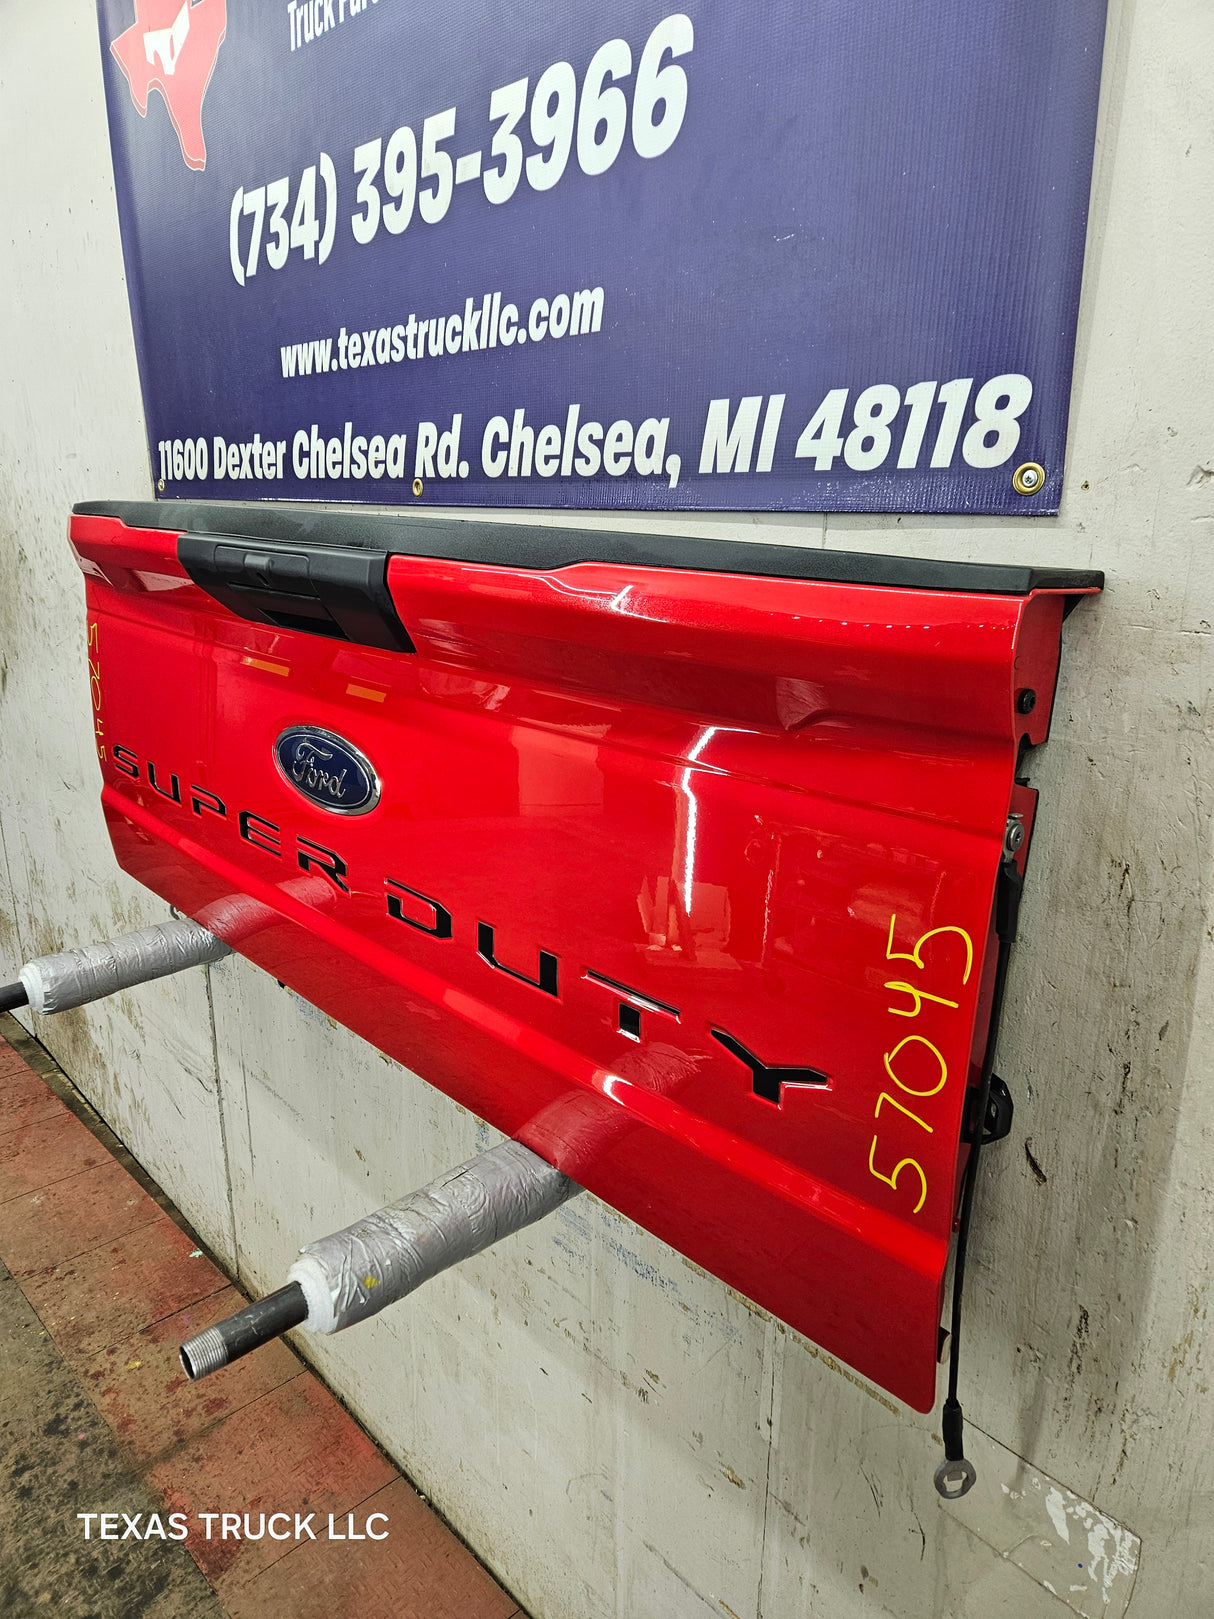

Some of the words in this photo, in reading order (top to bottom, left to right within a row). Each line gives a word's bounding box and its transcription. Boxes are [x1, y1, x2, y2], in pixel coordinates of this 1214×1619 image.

[229, 152, 337, 287] (734)
[350, 12, 694, 245] 395-3966
[280, 286, 605, 378] www.texastruckllc.com
[158, 436, 209, 481] 11600
[213, 433, 287, 480] Dexter
[292, 421, 407, 480] Chelsea
[414, 413, 470, 479] Rd.
[481, 403, 681, 489] Chelsea,
[698, 393, 787, 474] MI
[795, 373, 1034, 472] 48118
[292, 739, 348, 798] Ford
[112, 744, 351, 895] SUPER
[385, 877, 832, 1107] DUTY
[868, 913, 974, 1214] 57045
